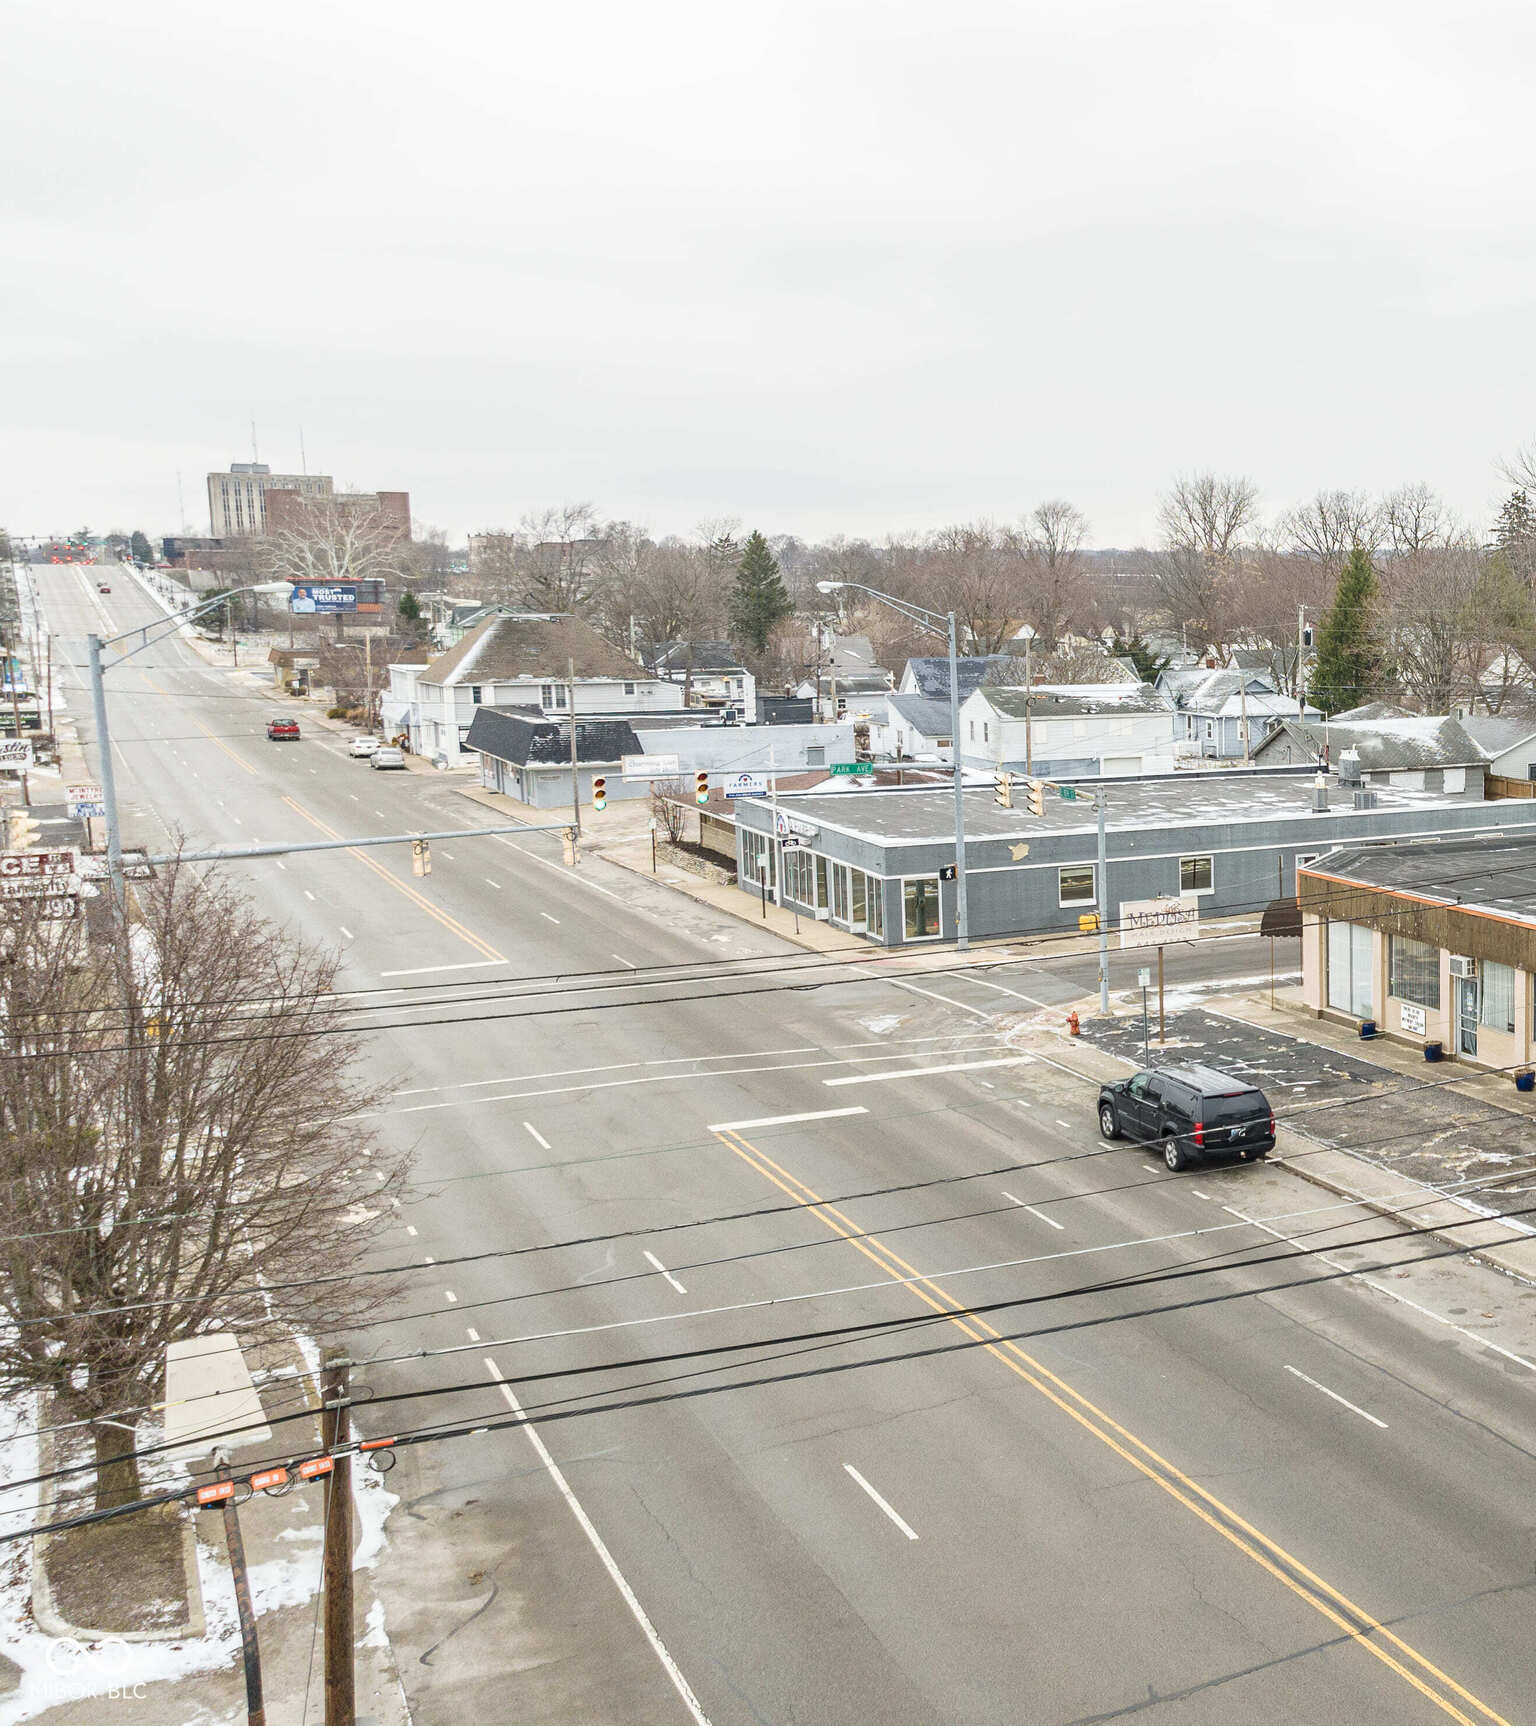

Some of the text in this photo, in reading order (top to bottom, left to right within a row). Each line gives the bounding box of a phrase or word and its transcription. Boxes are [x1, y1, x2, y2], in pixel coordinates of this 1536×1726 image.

[312, 587, 334, 595] MOST
[831, 765, 869, 774] PARK AVE
